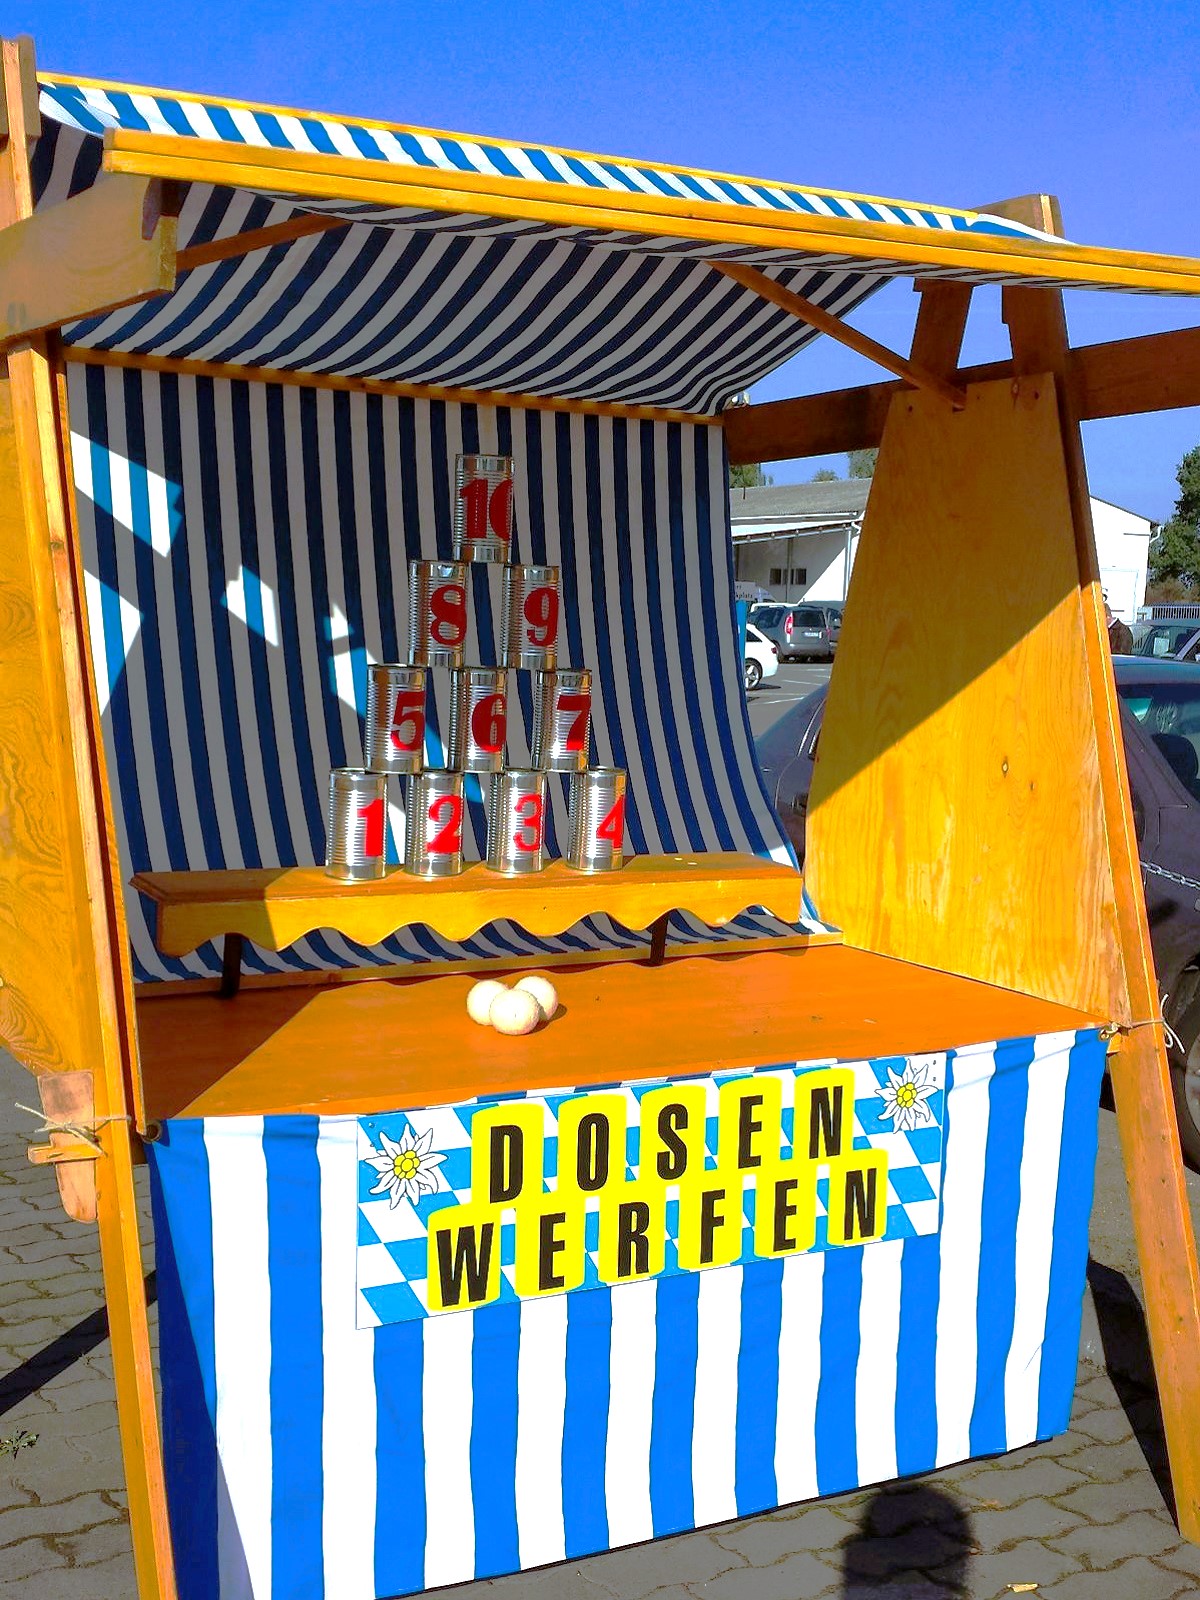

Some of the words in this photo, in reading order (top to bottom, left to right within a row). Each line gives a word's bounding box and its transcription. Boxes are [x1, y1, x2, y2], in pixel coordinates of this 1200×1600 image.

[430, 584, 467, 646] 8
[524, 587, 558, 646] 9
[390, 691, 425, 752] 5
[471, 694, 507, 753] 6
[556, 694, 591, 751] 7
[357, 798, 384, 857] 1
[425, 794, 463, 854] 2
[514, 793, 542, 852] 3
[596, 794, 625, 850] 4
[490, 1086, 842, 1203] DOSEN
[437, 1168, 876, 1306] WERFEN
